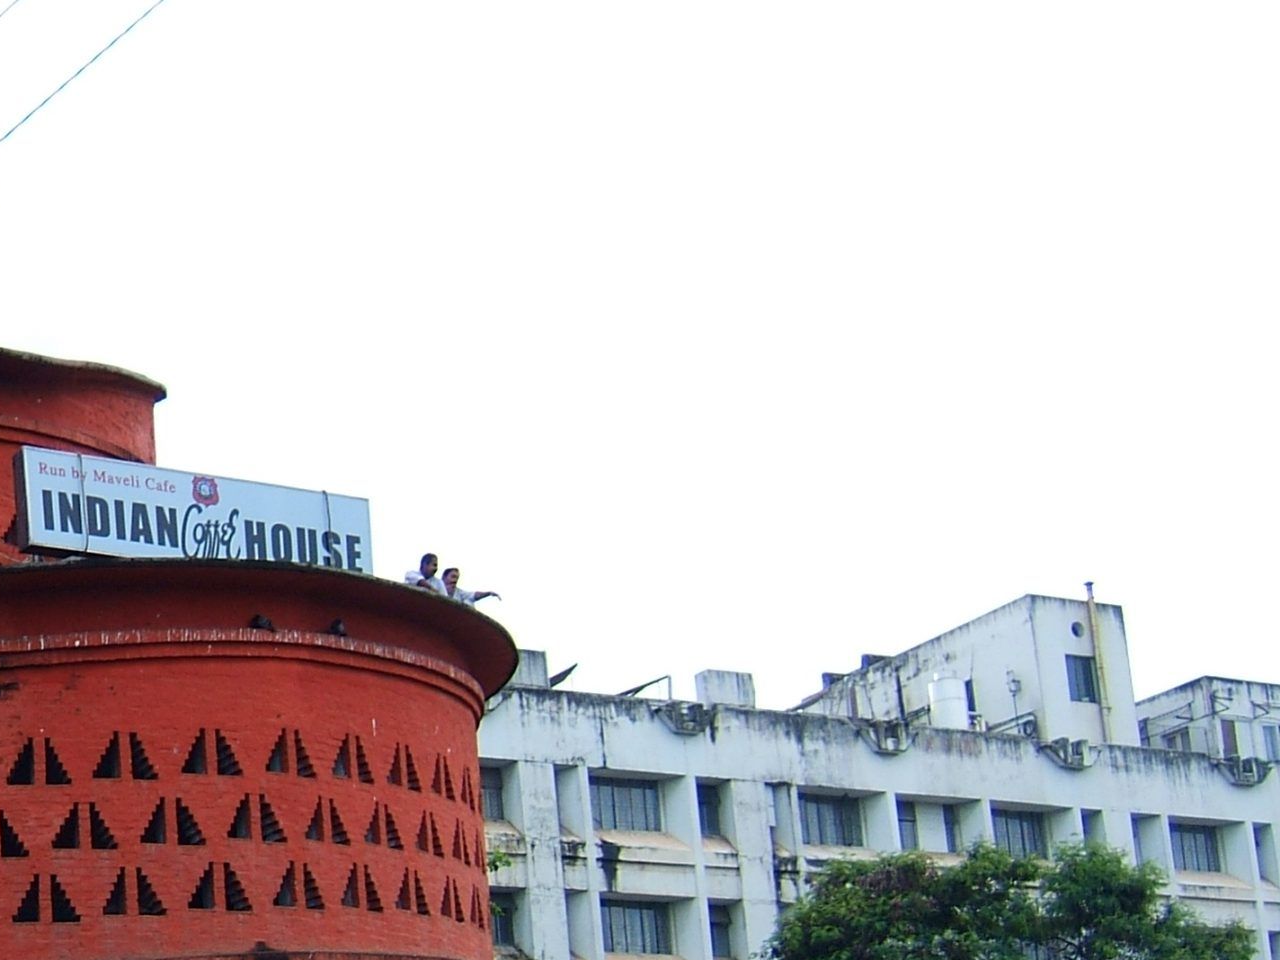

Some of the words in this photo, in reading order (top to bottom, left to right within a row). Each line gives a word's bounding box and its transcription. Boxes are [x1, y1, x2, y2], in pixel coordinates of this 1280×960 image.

[39, 462, 66, 478] Run
[72, 466, 86, 482] by
[93, 469, 140, 489] Maveli
[145, 477, 177, 494] Cafe
[41, 489, 181, 549] INDIAN
[244, 519, 364, 574] HOUSE
